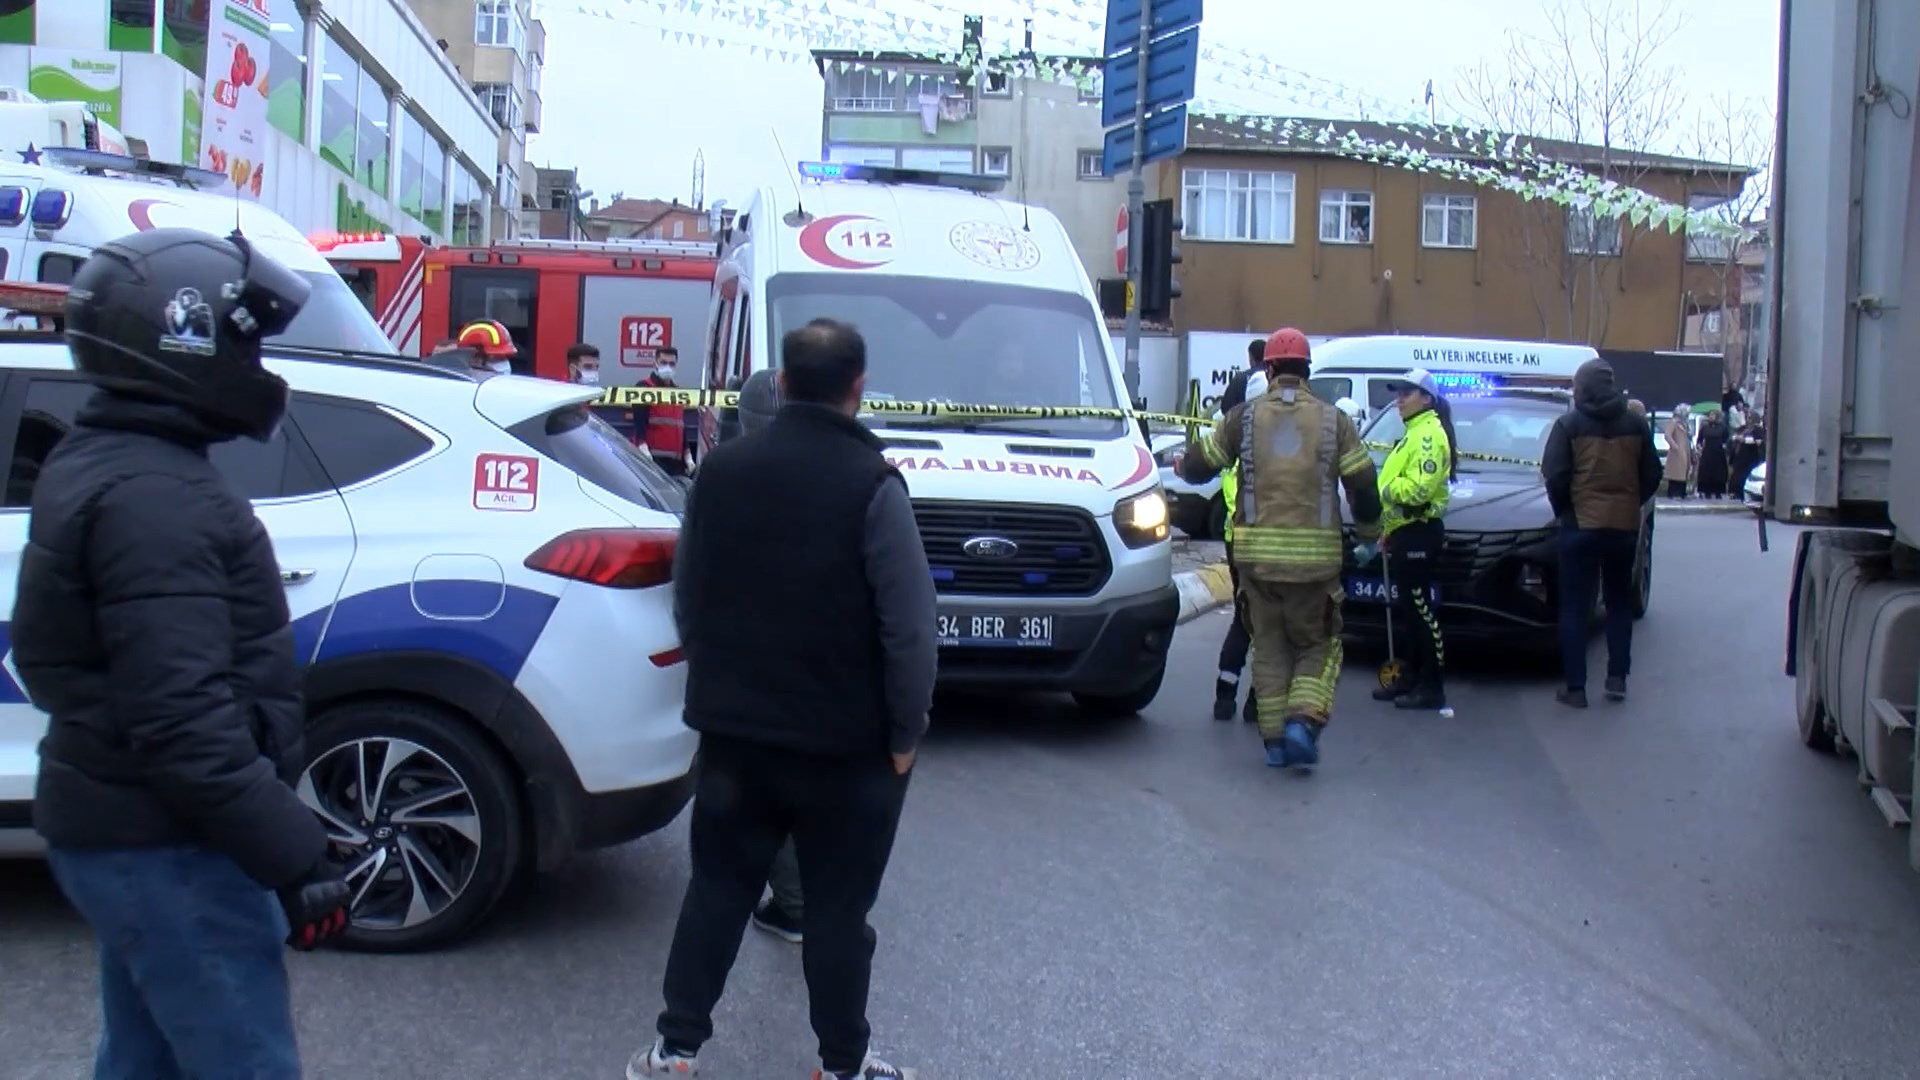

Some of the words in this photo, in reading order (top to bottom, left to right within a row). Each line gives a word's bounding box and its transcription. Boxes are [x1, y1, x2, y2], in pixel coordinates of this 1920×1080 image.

[840, 231, 893, 248] 112
[628, 322, 664, 346] 112
[1413, 349, 1439, 361] OLAY
[484, 460, 529, 490] 112
[1355, 581, 1372, 597] 34
[938, 616, 960, 638] 34
[971, 616, 1005, 638] BER
[1020, 616, 1049, 639] 361
